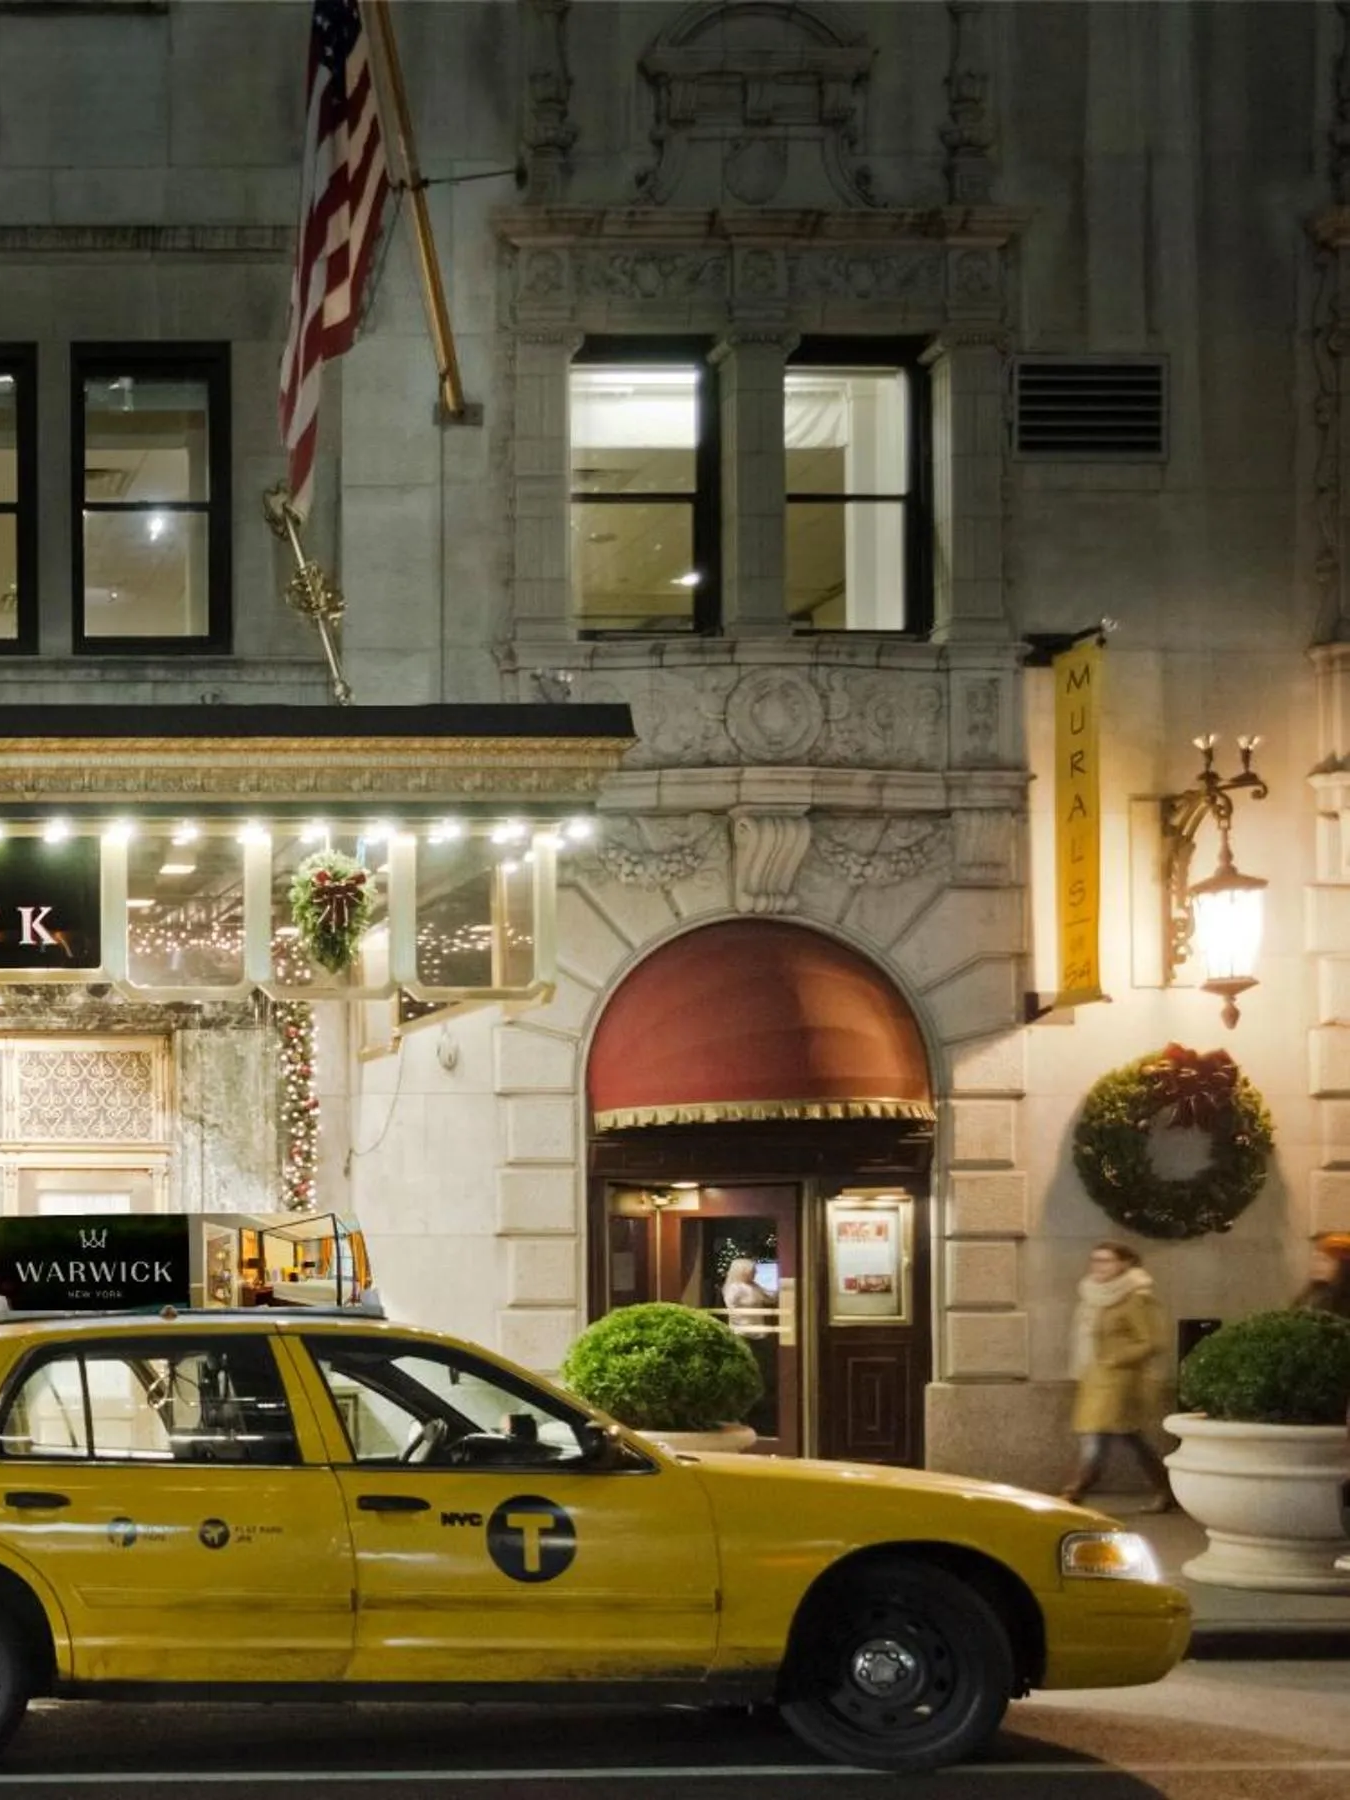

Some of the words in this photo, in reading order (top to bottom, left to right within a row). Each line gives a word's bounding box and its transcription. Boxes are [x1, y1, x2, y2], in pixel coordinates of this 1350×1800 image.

[1066, 664, 1090, 908] MURALS
[15, 1261, 173, 1283] WARWICK
[68, 1290, 91, 1298] NEW
[96, 1290, 122, 1298] YORK
[441, 1511, 483, 1527] NYC
[506, 1511, 555, 1573] T
